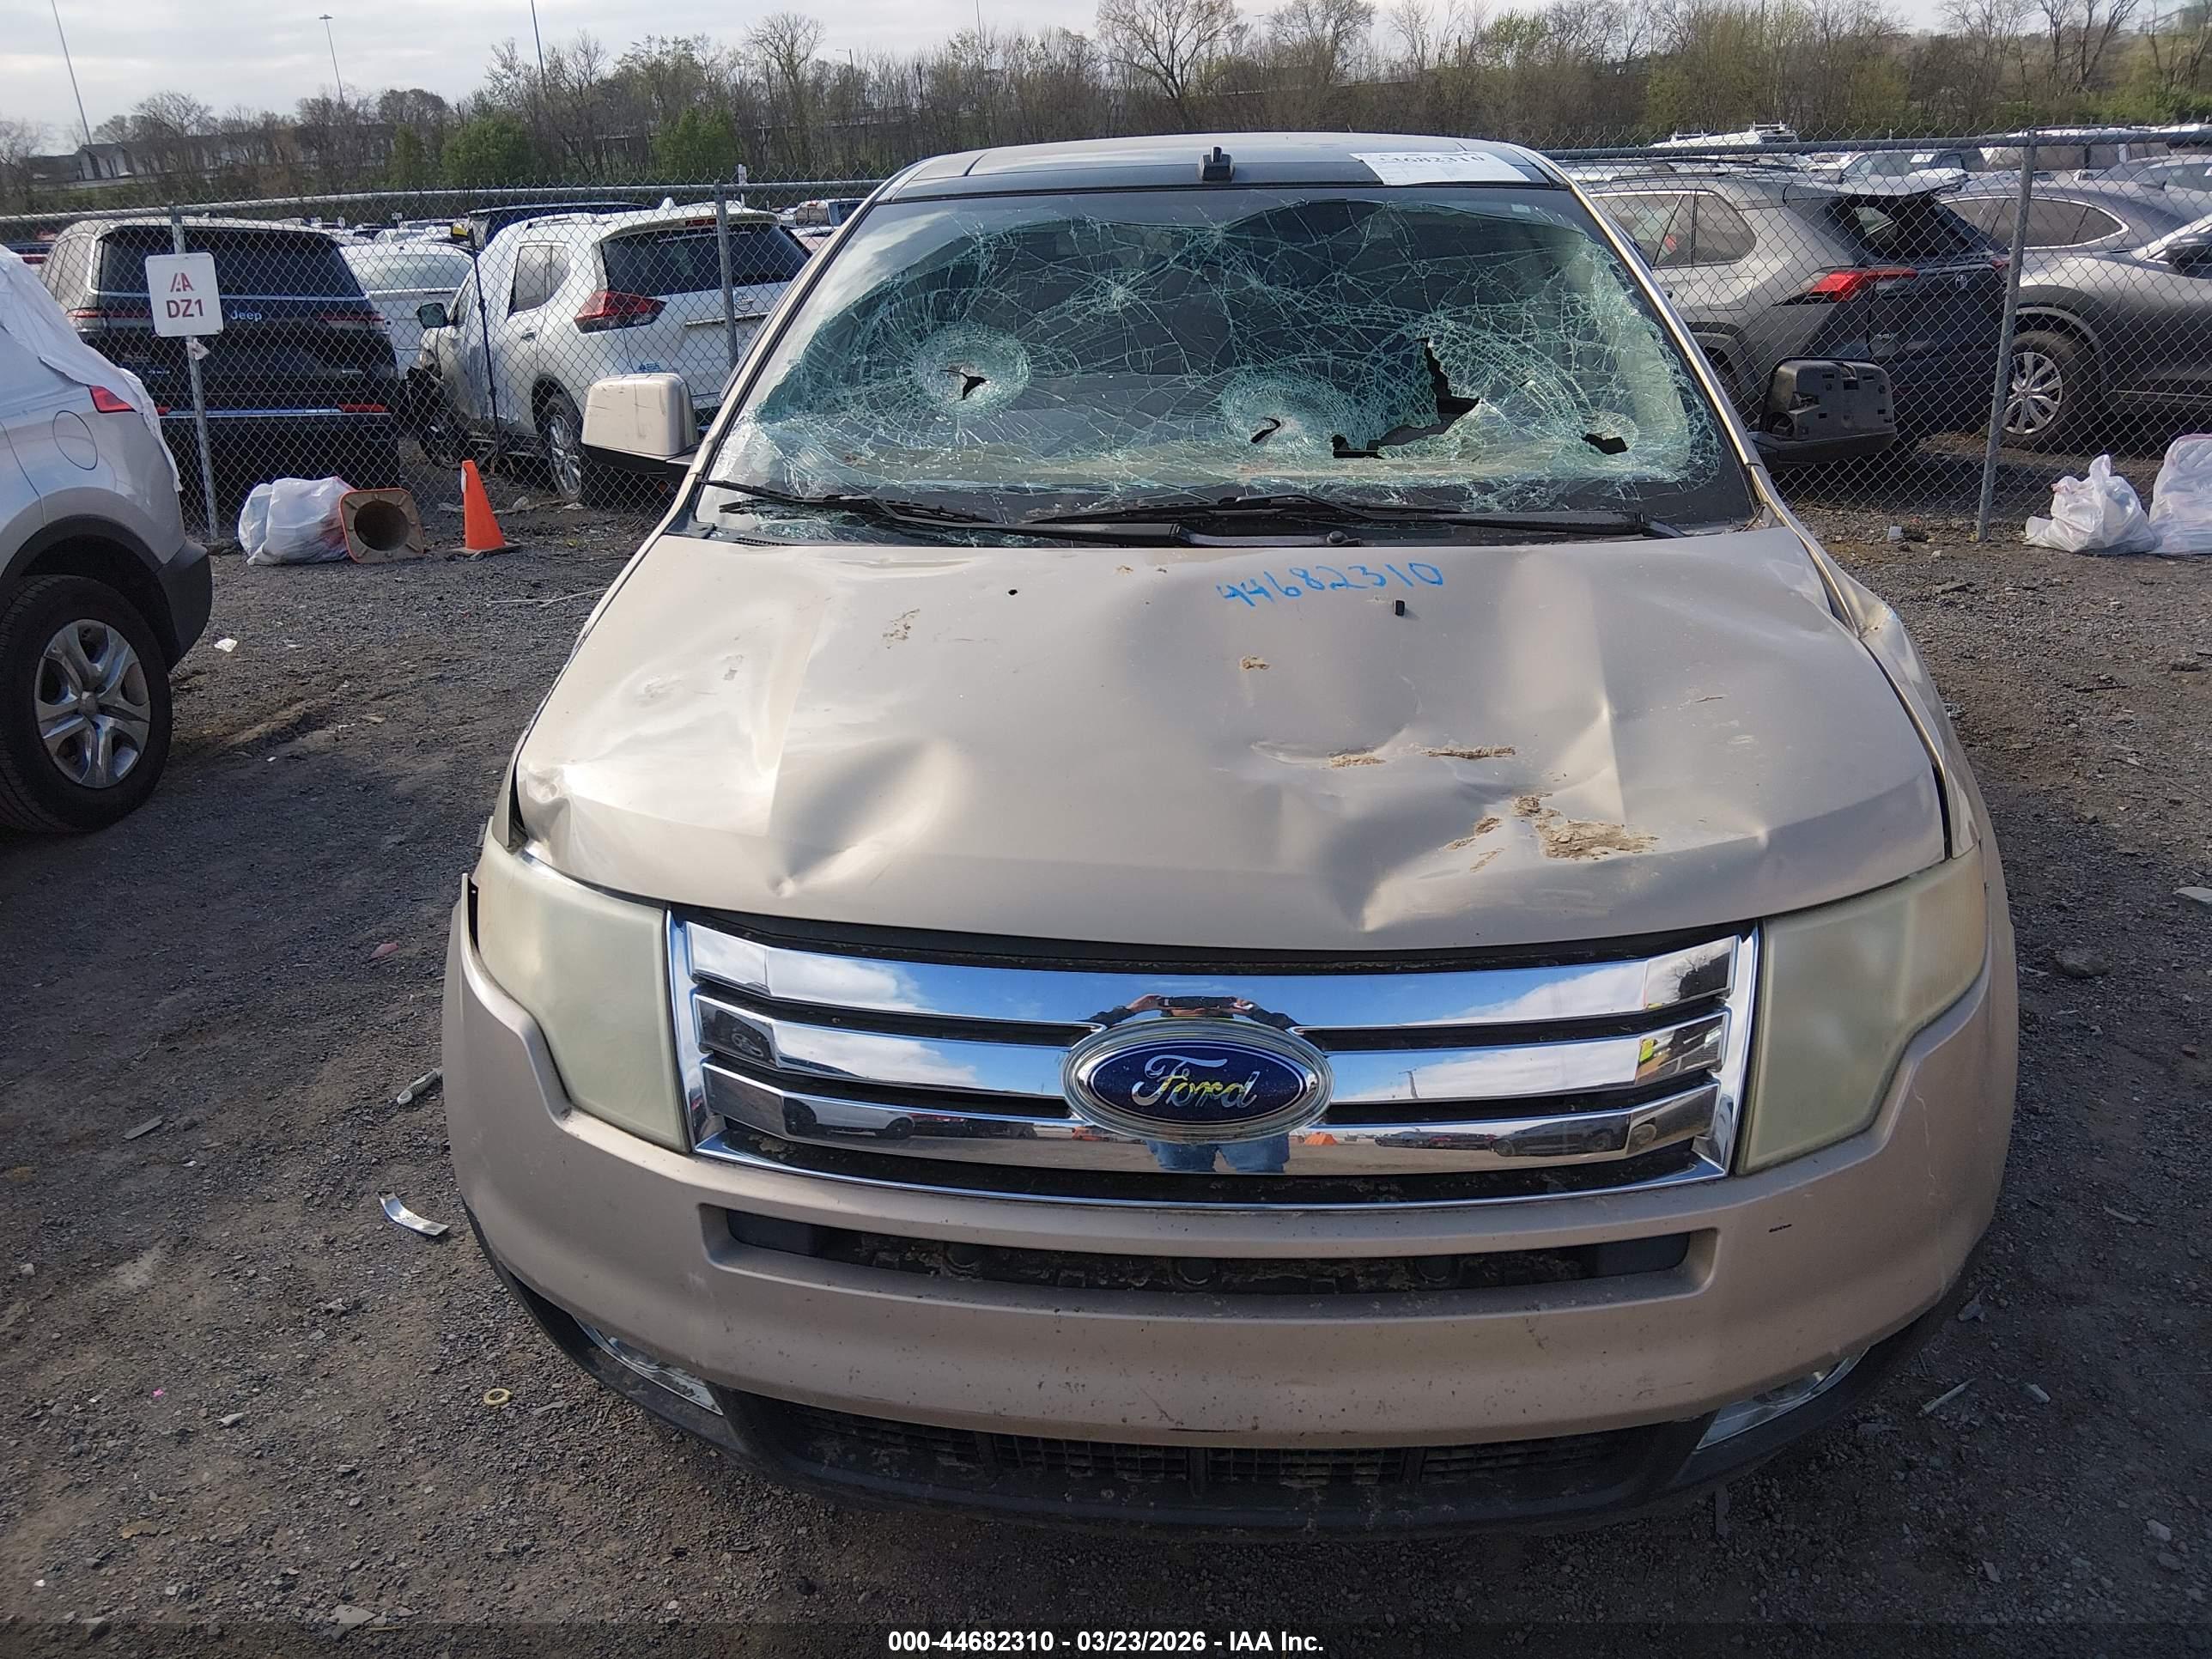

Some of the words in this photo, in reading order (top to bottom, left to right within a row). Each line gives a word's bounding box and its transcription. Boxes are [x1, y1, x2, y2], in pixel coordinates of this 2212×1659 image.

[166, 298, 204, 319] DZ1
[231, 310, 262, 322] Jeep
[1216, 562, 1443, 607] 44682310
[1131, 1054, 1261, 1109] Ford
